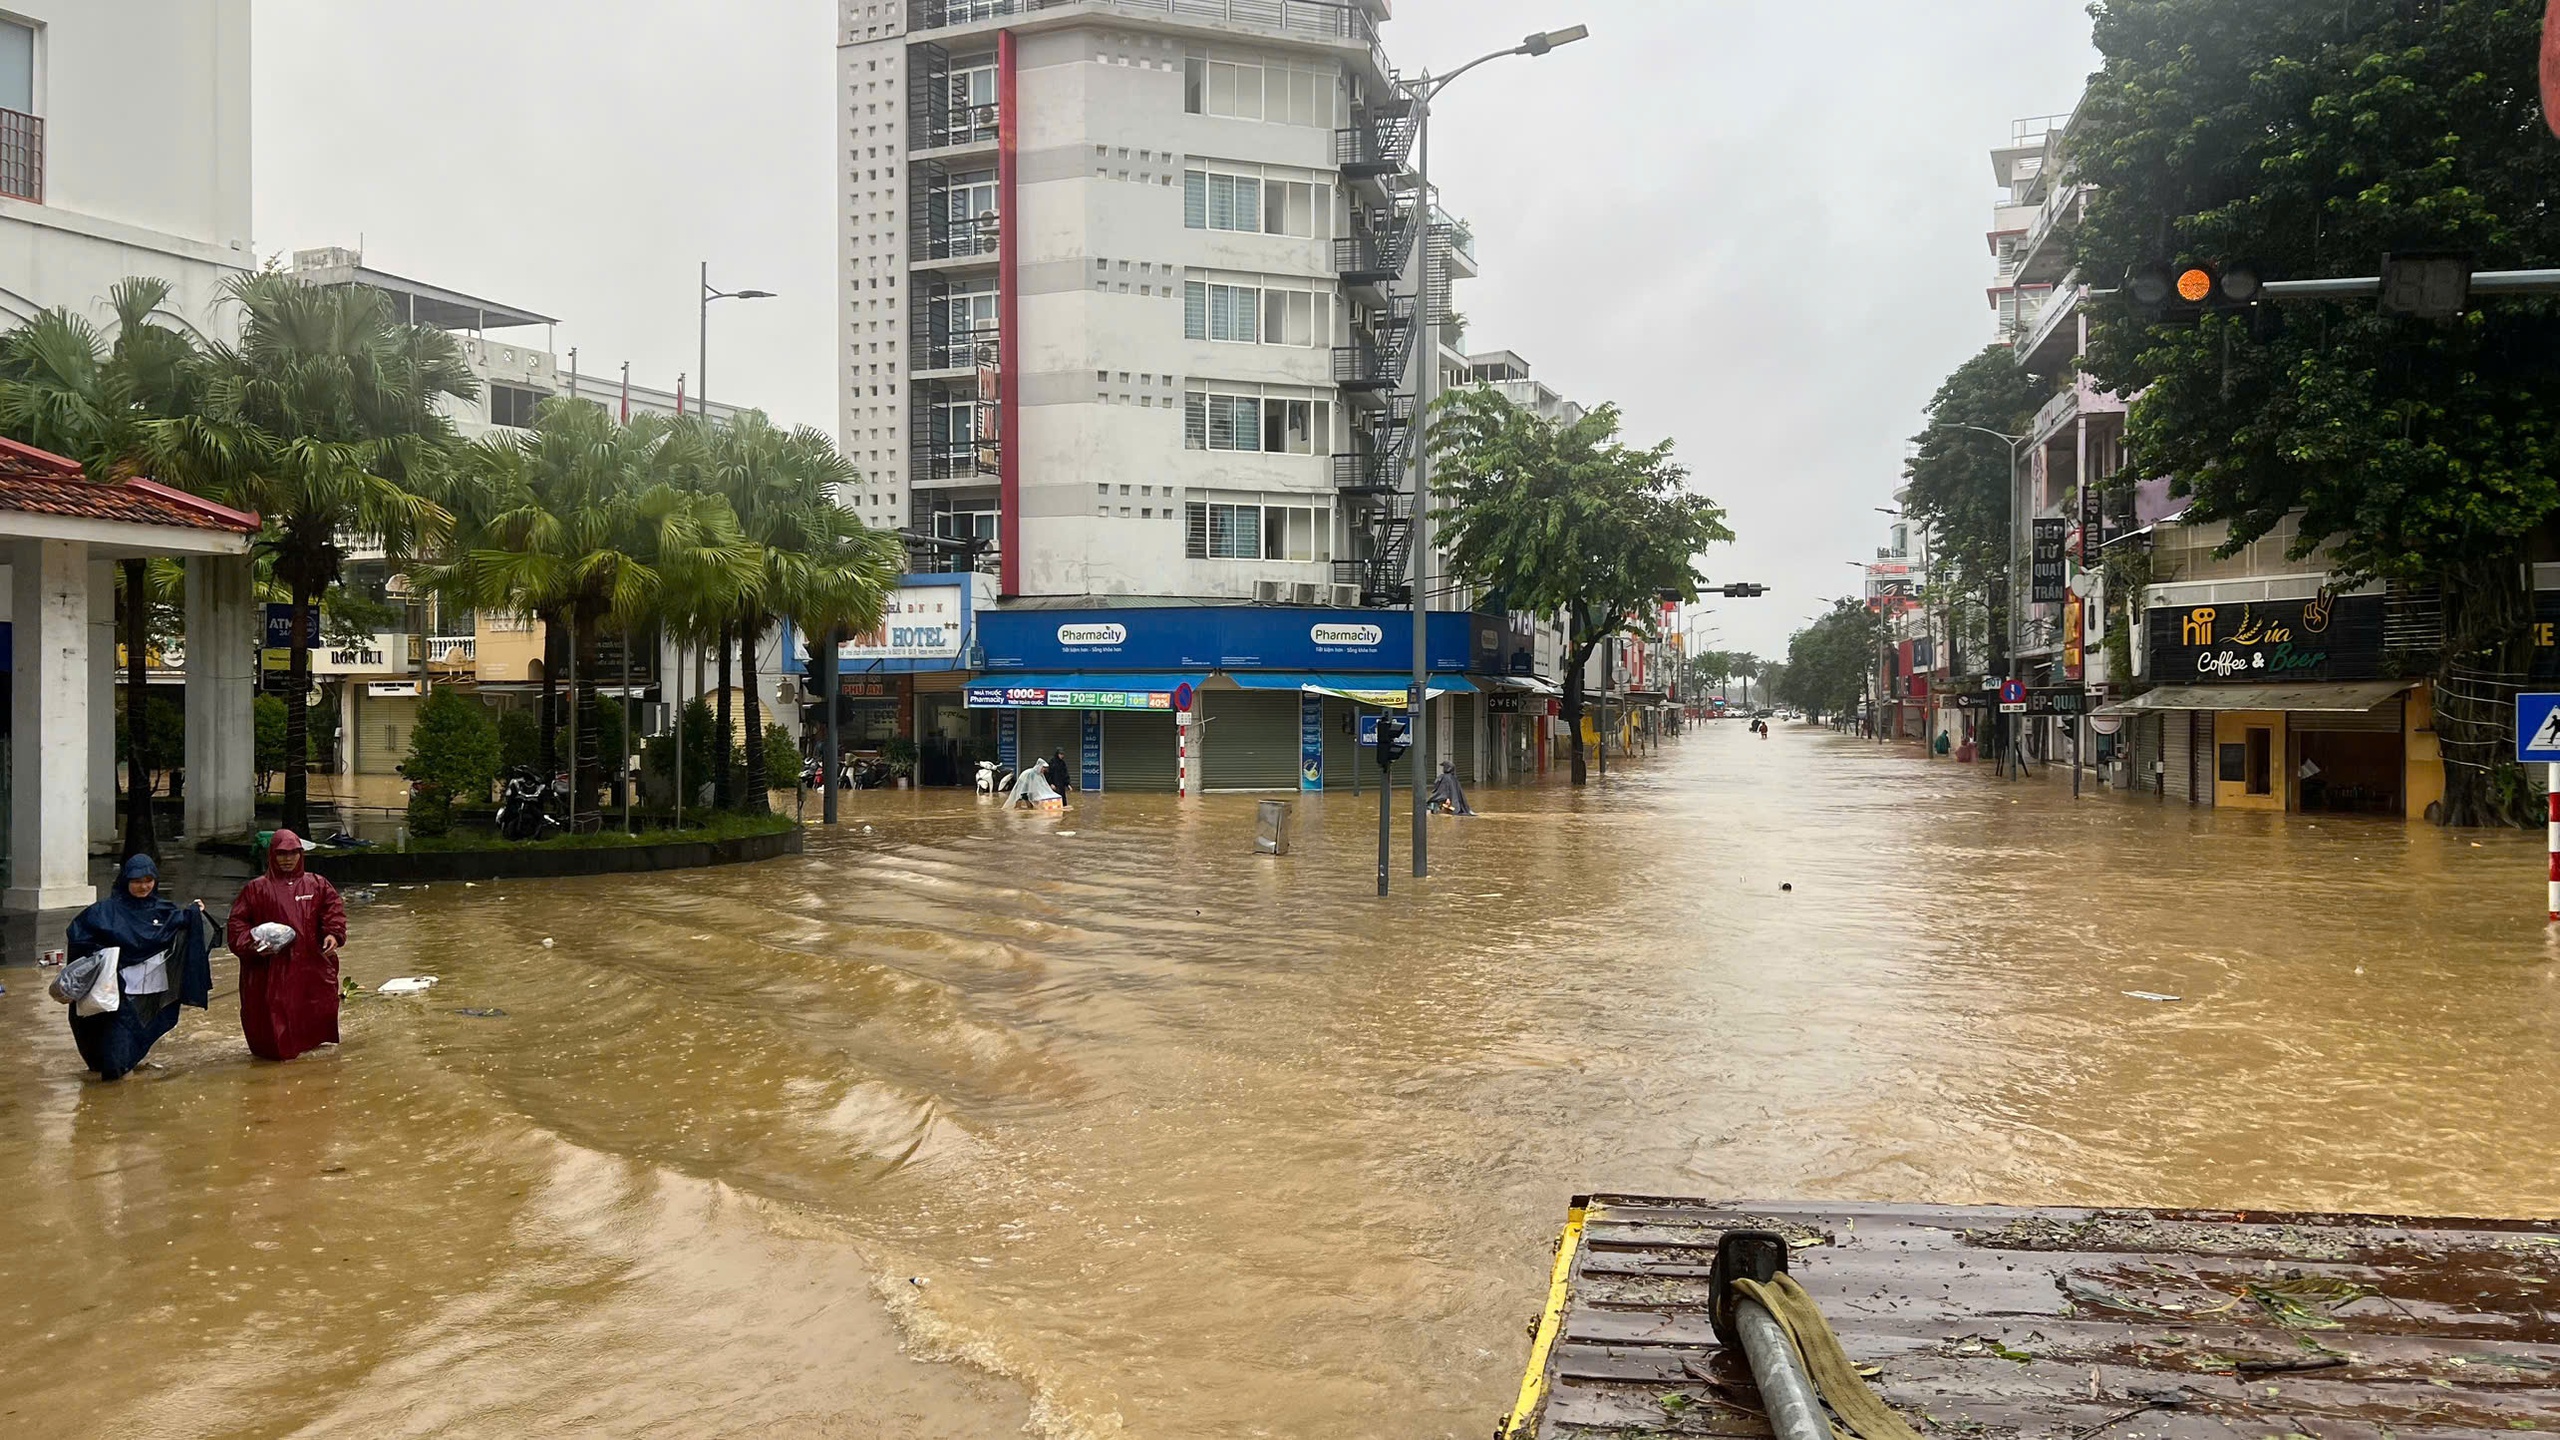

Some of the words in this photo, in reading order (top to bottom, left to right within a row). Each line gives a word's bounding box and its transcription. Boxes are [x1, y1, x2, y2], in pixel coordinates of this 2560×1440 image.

[2034, 523, 2063, 539] BẾP
[1508, 609, 1534, 637] OWEN
[892, 627, 946, 647] HOTEL
[1062, 625, 1122, 643] Pharmacity
[1315, 626, 1378, 643] Pharmacity
[2197, 650, 2248, 677] Coffee
[2252, 652, 2265, 668] &
[2269, 642, 2327, 672] Beer
[970, 695, 1004, 705] Pharmacity
[1072, 693, 1085, 703] 70
[1100, 694, 1113, 703] 40
[1149, 699, 1168, 707] 40%
[1489, 698, 1518, 708] OWEN
